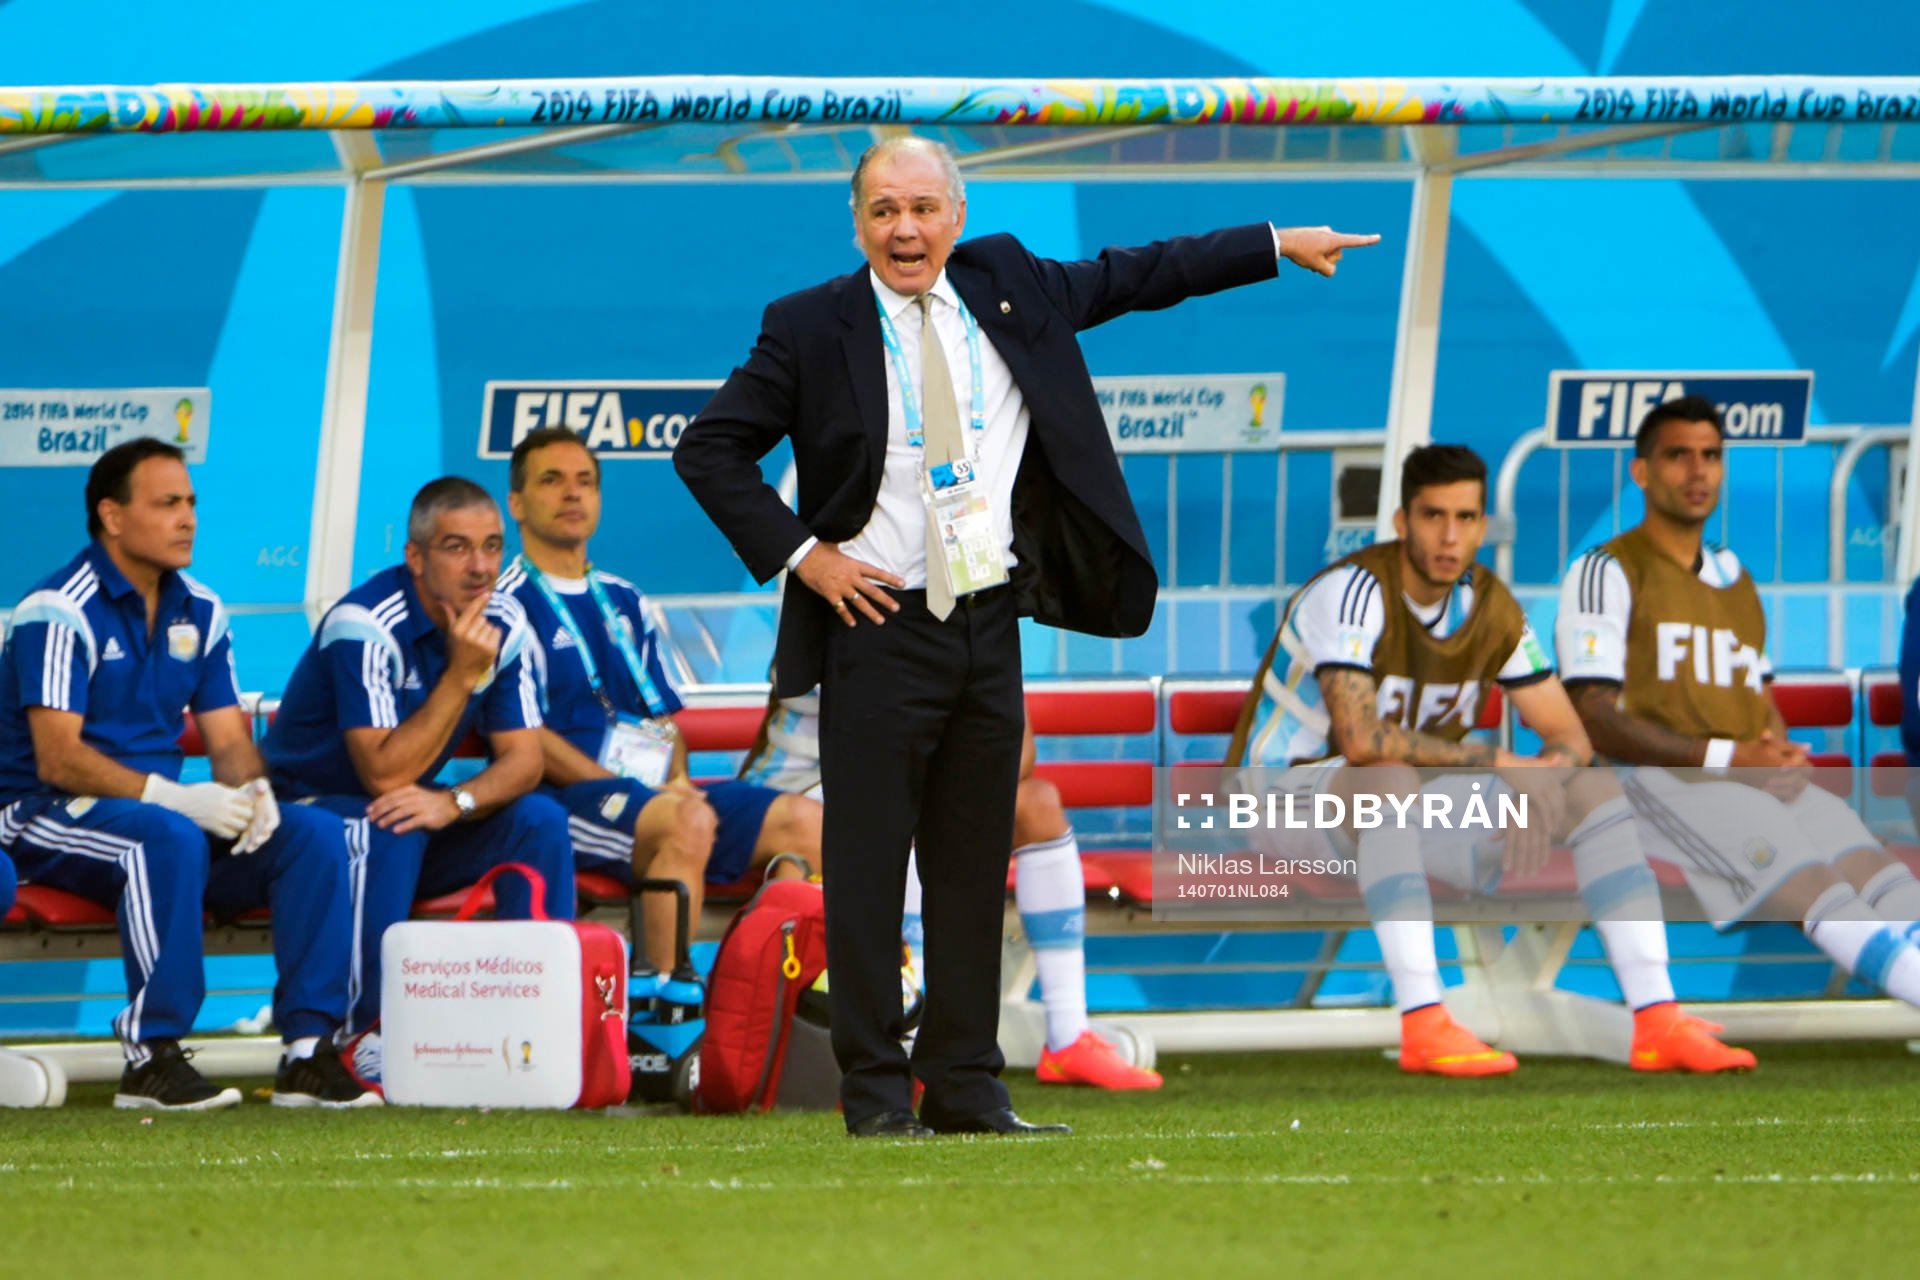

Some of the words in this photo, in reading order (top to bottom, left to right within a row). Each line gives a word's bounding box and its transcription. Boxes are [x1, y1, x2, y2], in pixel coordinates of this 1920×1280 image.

[602, 90, 659, 122] FIFA
[670, 89, 751, 124] World
[761, 88, 812, 122] Cup
[1643, 88, 1698, 118] FIFA
[1708, 88, 1788, 120] World
[1799, 88, 1847, 120] Cup
[1119, 389, 1147, 406] FIFA
[1152, 388, 1193, 406] World
[1198, 386, 1225, 408] Cup
[3, 403, 35, 421] 2014
[40, 403, 68, 418] FIFA
[74, 402, 116, 419] World
[120, 402, 150, 425] Cup
[257, 545, 300, 567] AGC
[401, 958, 471, 978] Serviços
[475, 956, 544, 975] Médicos
[404, 981, 466, 998] Medical
[470, 981, 541, 998] Services
